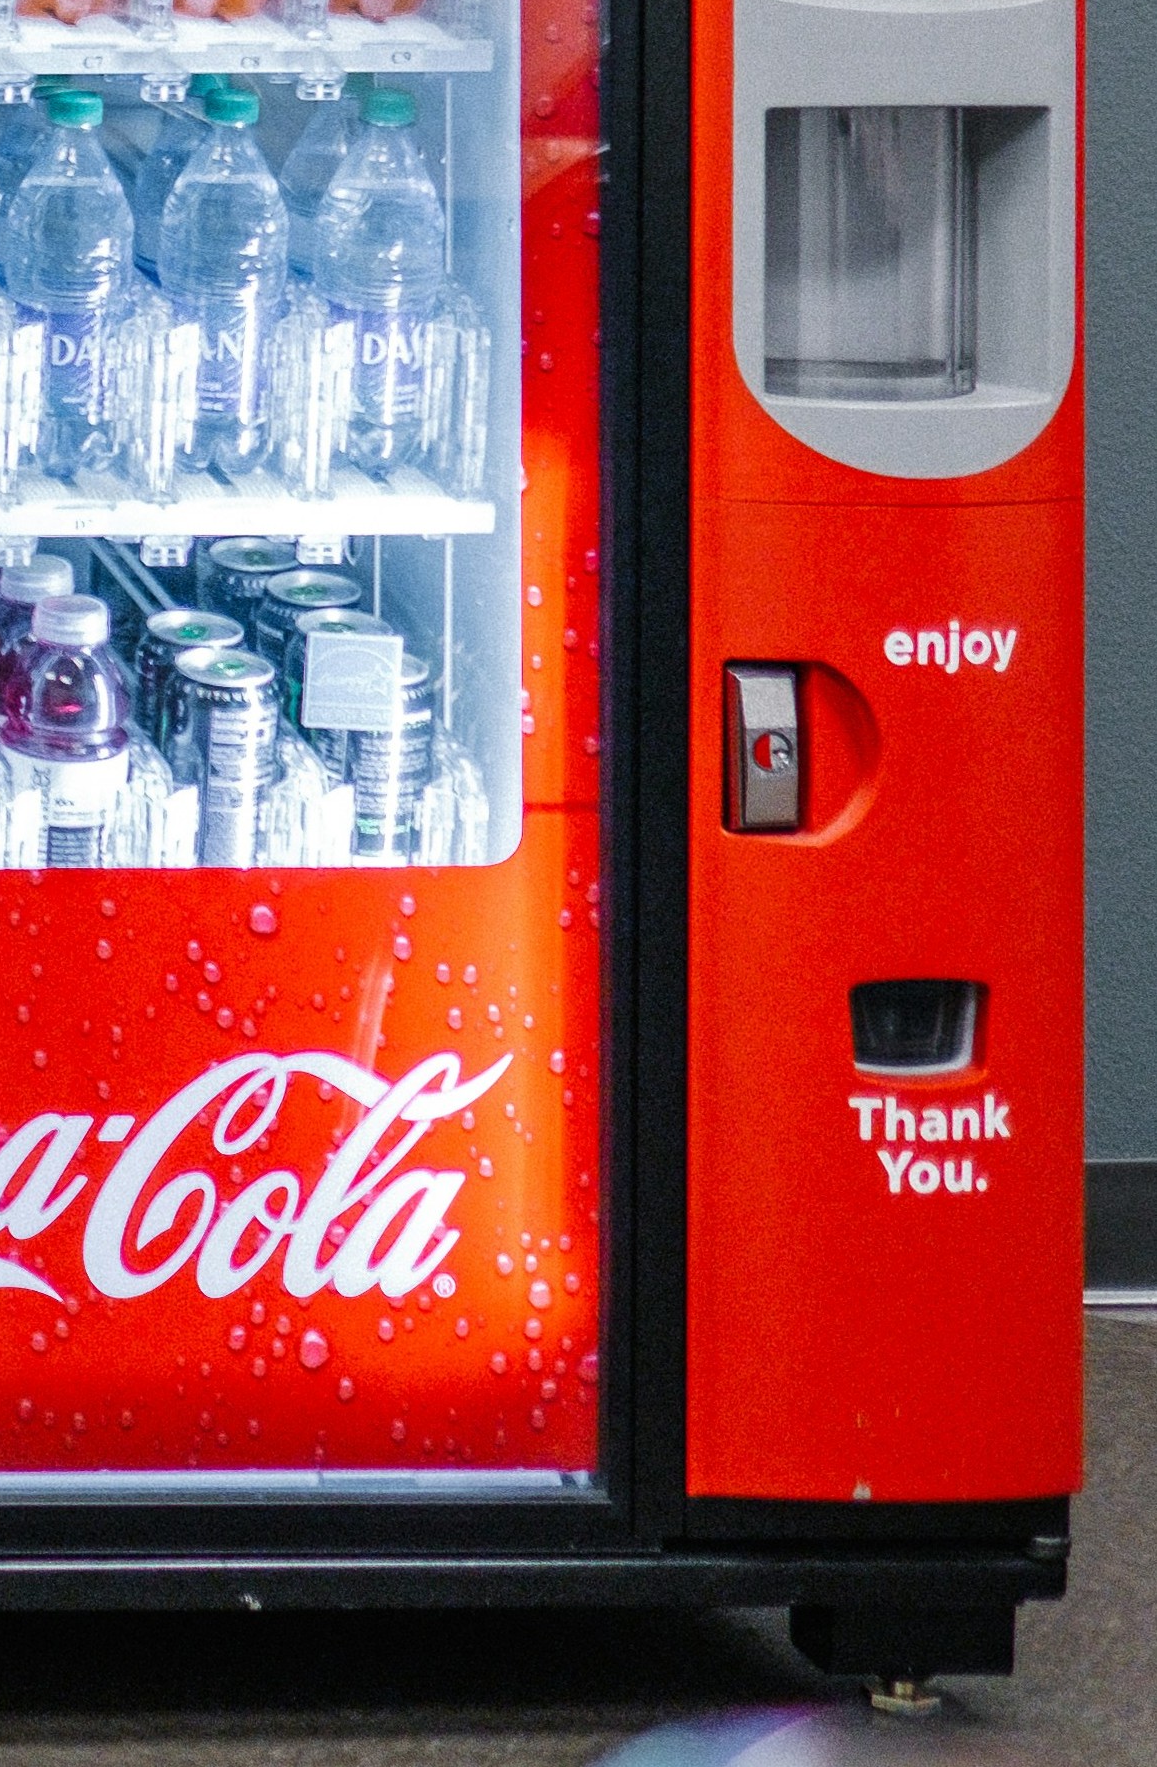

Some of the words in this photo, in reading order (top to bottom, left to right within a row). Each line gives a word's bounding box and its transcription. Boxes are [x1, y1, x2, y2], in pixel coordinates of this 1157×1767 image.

[83, 57, 103, 69] C7
[241, 57, 260, 69] C8
[391, 51, 411, 64] C9
[884, 620, 1017, 674] enjoy
[848, 1094, 1010, 1141] Thank
[877, 1150, 988, 1194] You.
